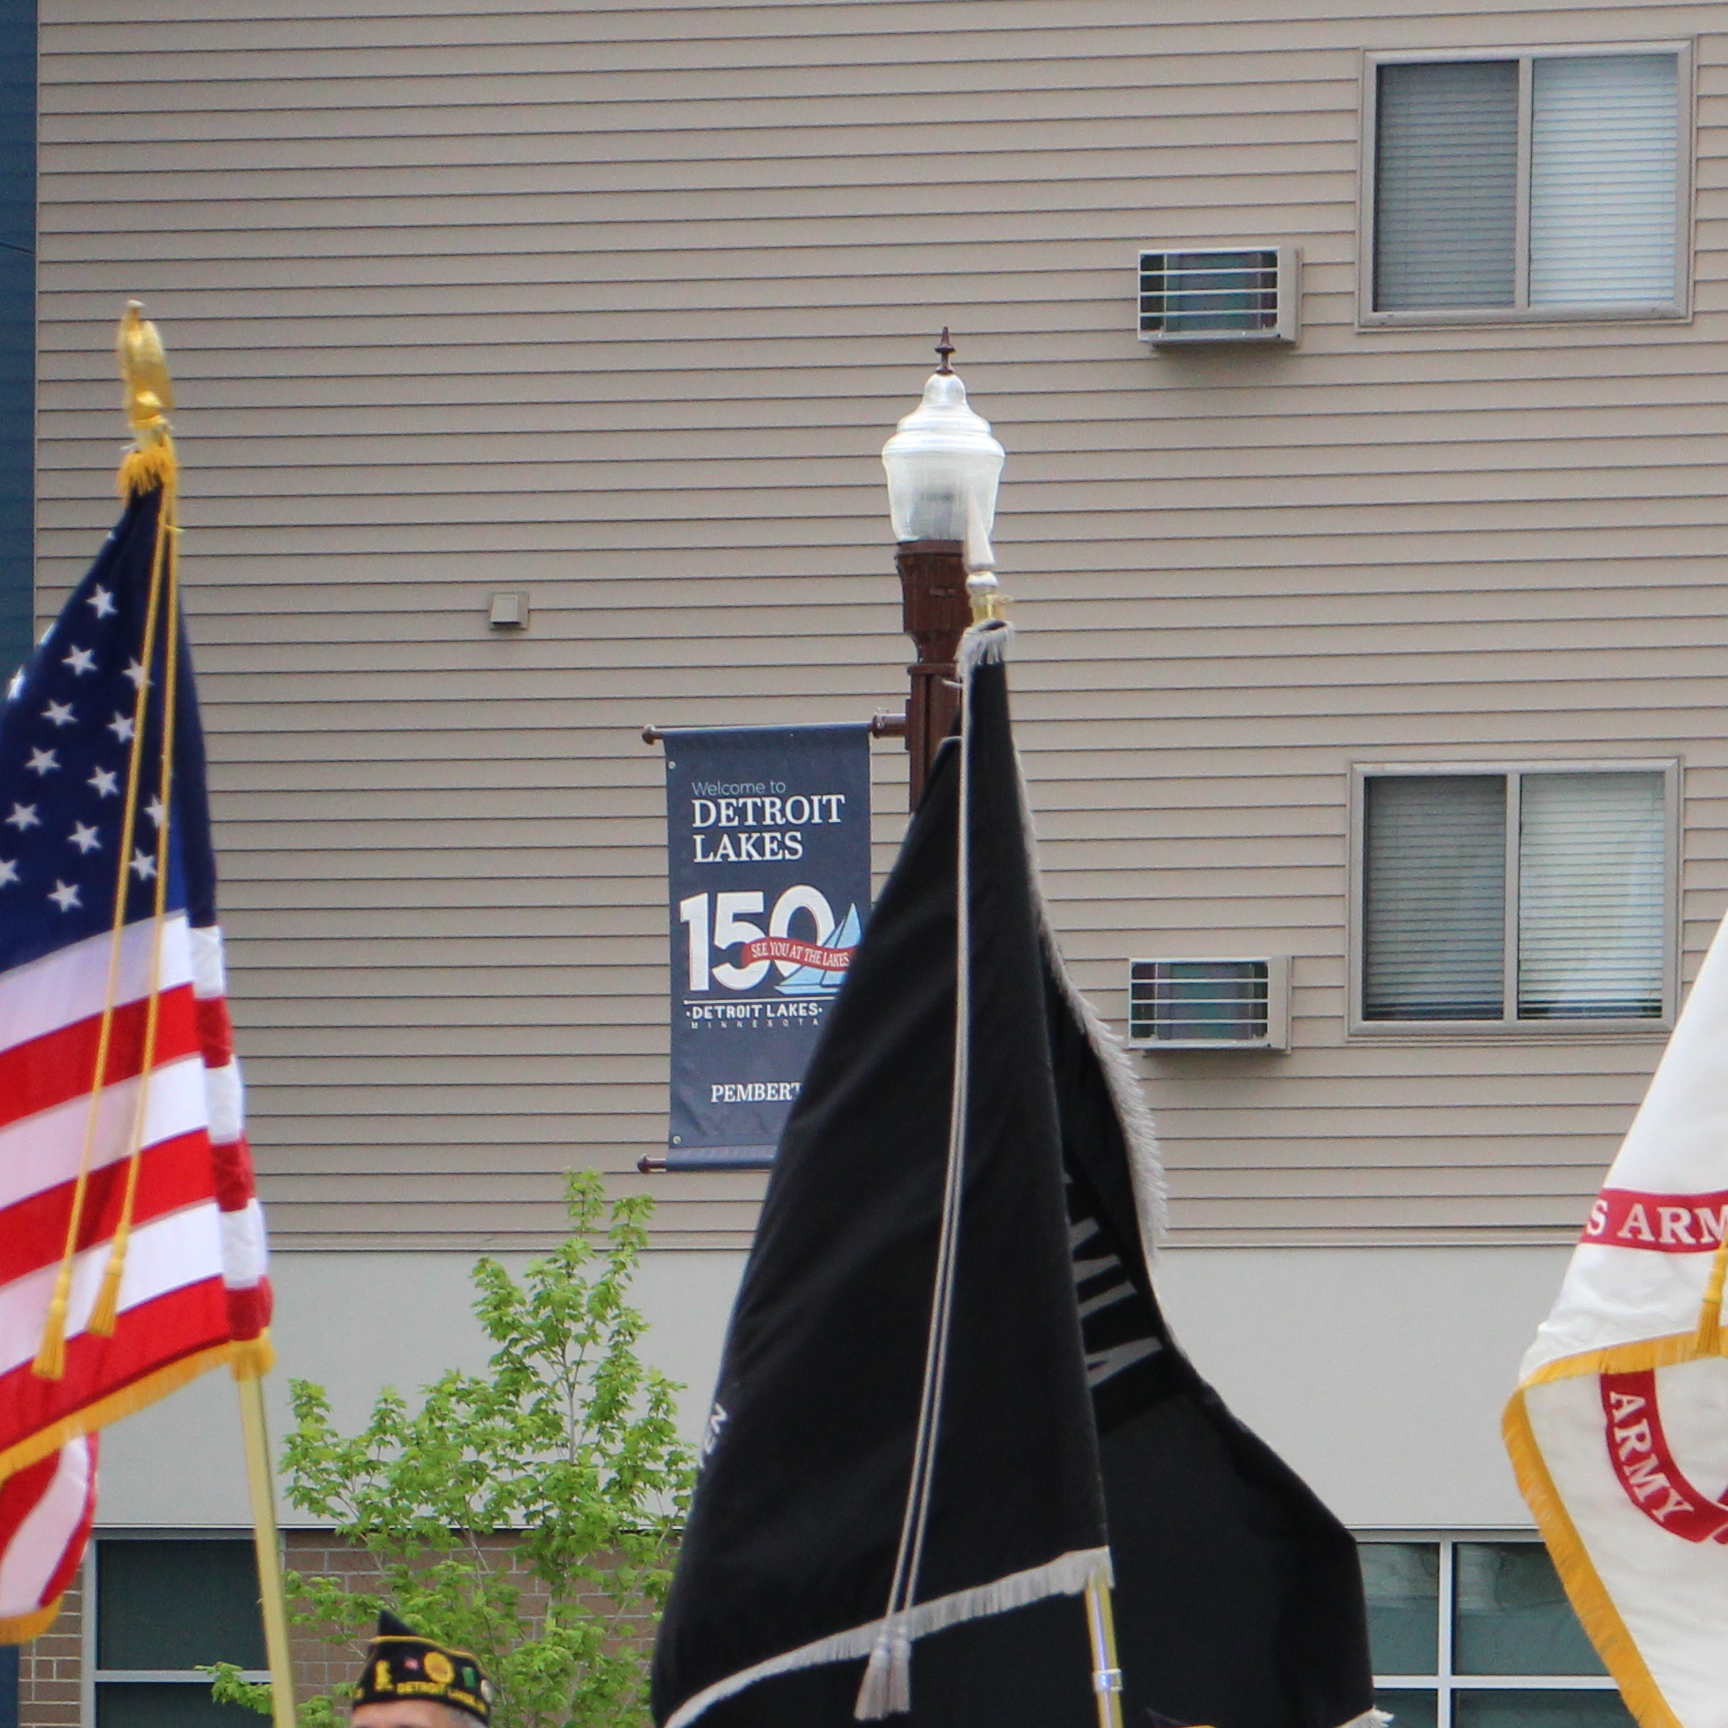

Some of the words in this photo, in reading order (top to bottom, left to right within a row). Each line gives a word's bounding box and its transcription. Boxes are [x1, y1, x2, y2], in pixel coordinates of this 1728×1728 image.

[691, 781, 765, 796] Welcome
[770, 780, 786, 793] to
[691, 794, 846, 828] DETROIT
[693, 831, 803, 863] LAKES
[680, 884, 835, 991] 150
[750, 942, 768, 958] SEE
[770, 942, 790, 958] YOU
[791, 945, 804, 960] AT
[804, 948, 821, 965] THE
[822, 952, 850, 968] LAKES
[691, 1019, 819, 1030] MINNESOTA
[692, 1004, 763, 1020] DETROIT
[767, 1003, 819, 1017] LAKES
[1610, 1390, 1696, 1524] ARMY
